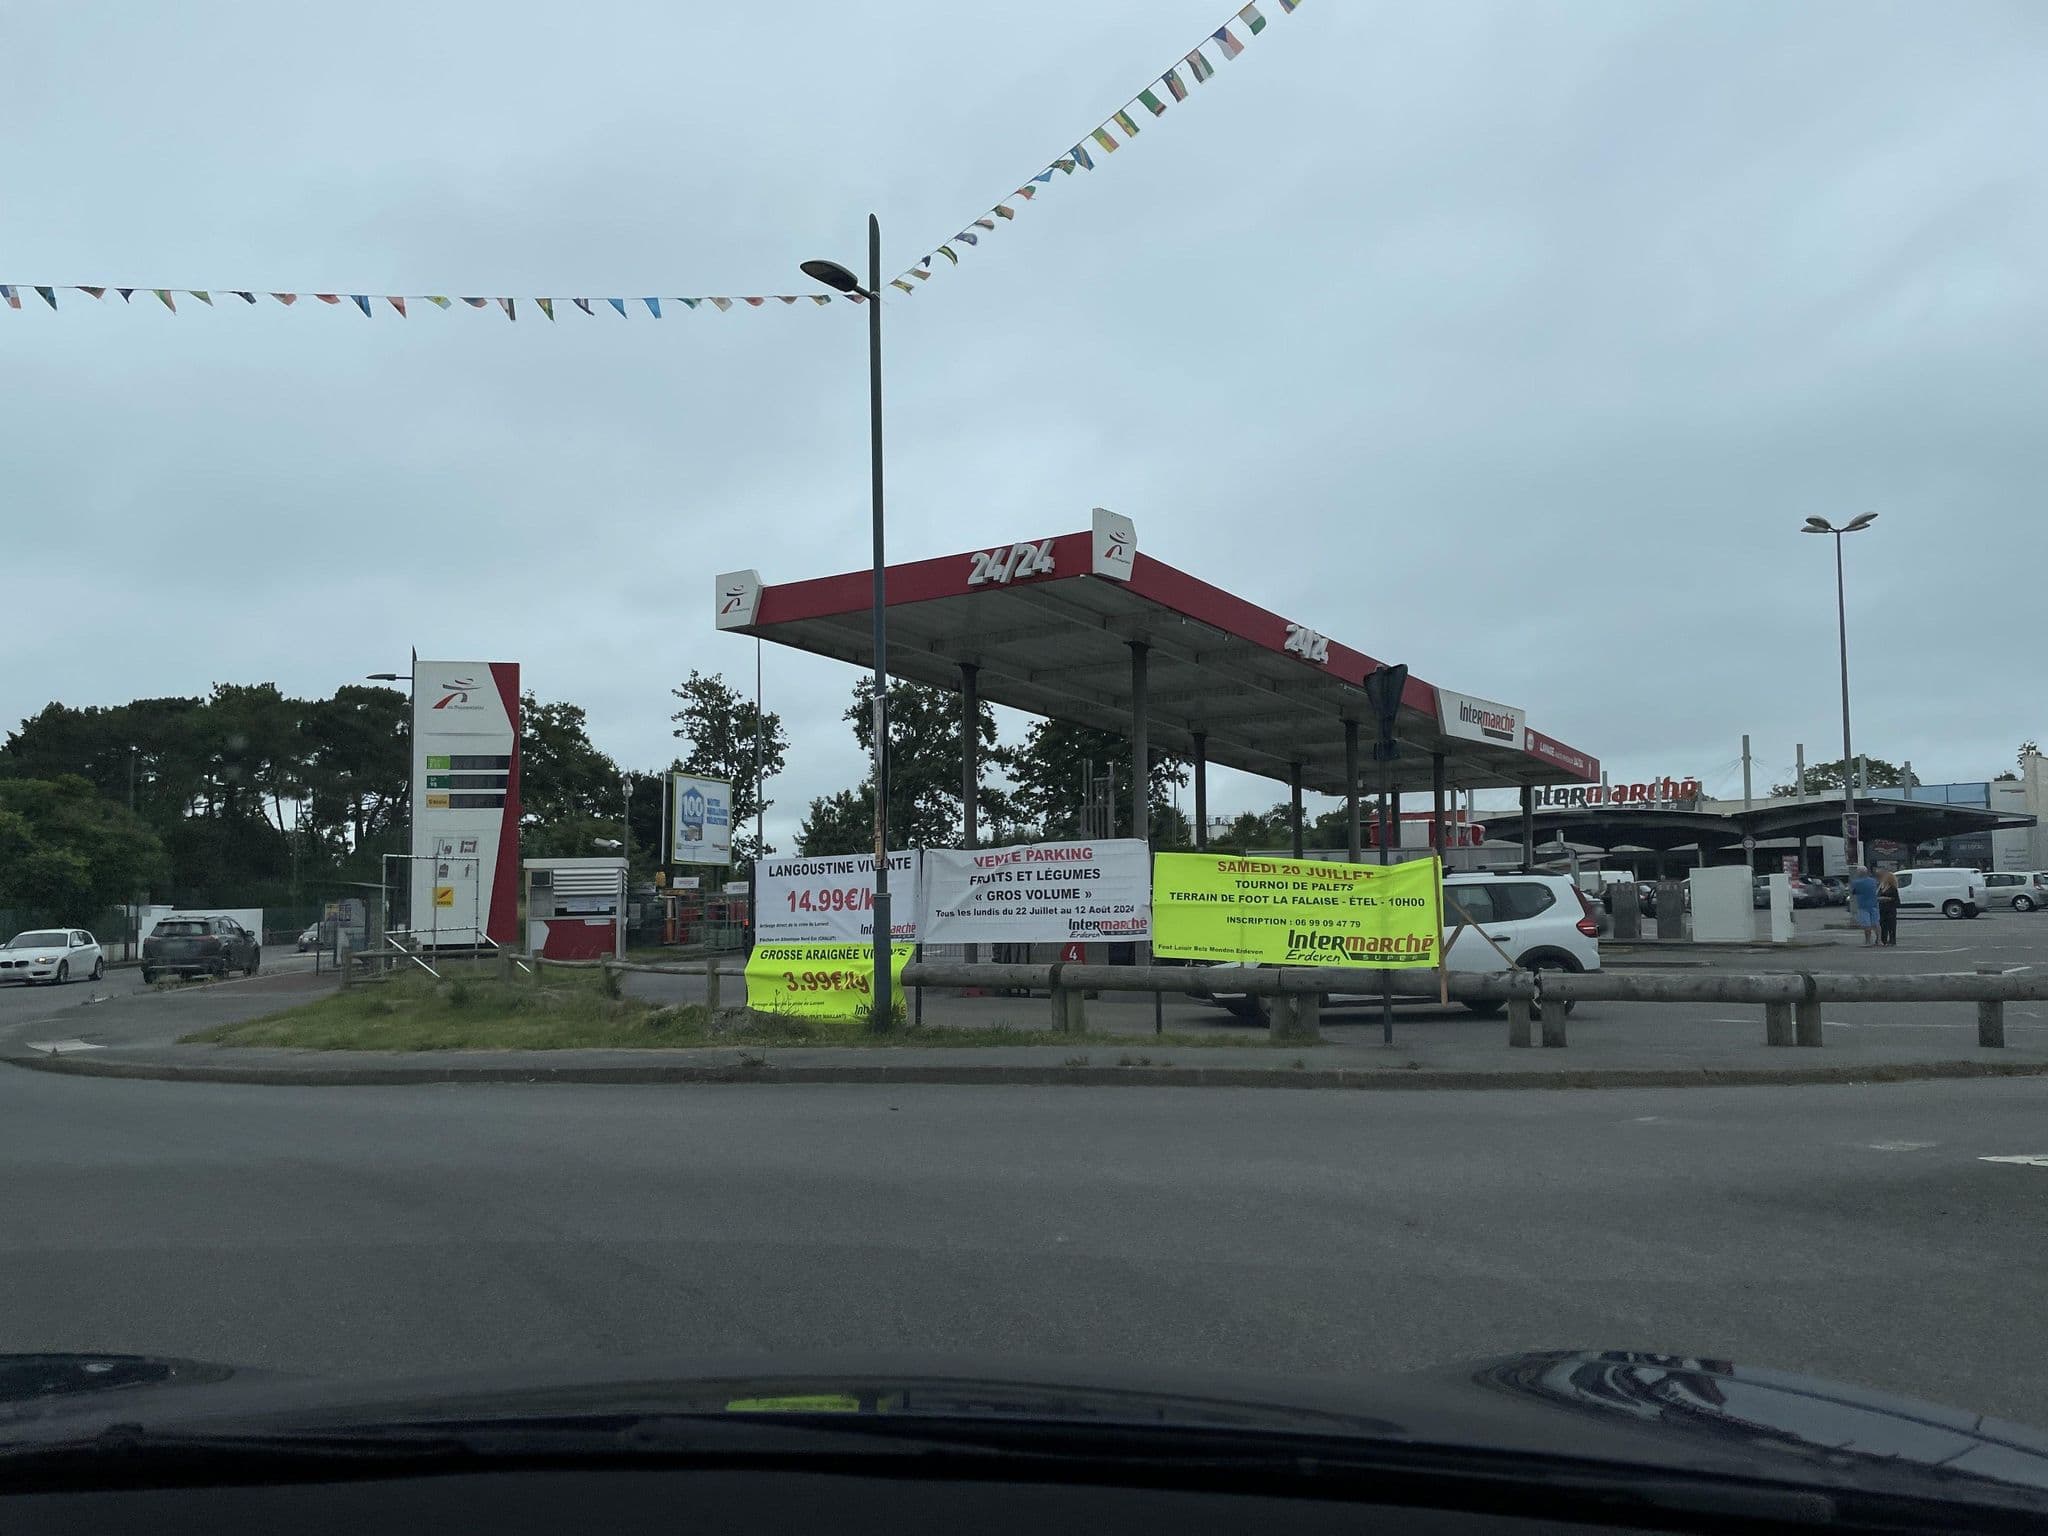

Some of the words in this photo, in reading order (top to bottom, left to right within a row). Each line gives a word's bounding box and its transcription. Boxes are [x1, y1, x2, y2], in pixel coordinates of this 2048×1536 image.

[968, 538, 1055, 585] 24/24
[1284, 624, 1329, 664] 24/24
[1460, 701, 1516, 732] Intermarché
[974, 851, 1021, 867] VENTE
[1026, 847, 1093, 861] PARKING
[768, 860, 854, 877] LANGOUSTINE
[858, 857, 912, 873] VIVNTE
[1217, 861, 1277, 873] SAMEDI
[1281, 865, 1301, 875] 20
[1306, 867, 1374, 880] JUILLET
[969, 871, 1013, 886] FRUITS
[1016, 871, 1033, 881] ET
[1036, 867, 1101, 880] LÉGUMES
[1235, 880, 1289, 890] TOURNOI
[1292, 881, 1308, 890] DE
[1311, 882, 1354, 891] PALETS
[986, 889, 1022, 901] GROS
[1025, 888, 1081, 900] VOLUME
[1169, 892, 1218, 902] TERRAIN
[1221, 893, 1235, 903] DE
[1238, 894, 1270, 904] FOOT
[1273, 896, 1288, 904] LA
[1292, 896, 1339, 906] FALAISE
[1349, 895, 1378, 906] ÉTEL
[1388, 897, 1425, 907] 10H00
[935, 909, 955, 917] Tous
[957, 908, 971, 917] les
[973, 907, 1000, 916] lundis
[1002, 907, 1013, 916] du
[1015, 907, 1027, 915] 22
[1029, 906, 1058, 915] Juillet
[1075, 906, 1086, 914] 12
[1089, 905, 1111, 914] Août
[1113, 904, 1135, 914] 2024
[1068, 917, 1148, 931] Intermarché
[1226, 916, 1287, 926] INSCRIPTION
[1295, 918, 1306, 927] 06
[1309, 919, 1320, 927] 99
[1323, 919, 1333, 927] 09
[1336, 919, 1347, 927] 47
[1350, 920, 1361, 928] 79
[1287, 929, 1435, 953] Intermarché
[760, 949, 803, 960] GROSSE
[805, 946, 859, 960] ARAIGNÉE
[1069, 945, 1078, 960] 4
[1285, 949, 1341, 963] Erdeven
